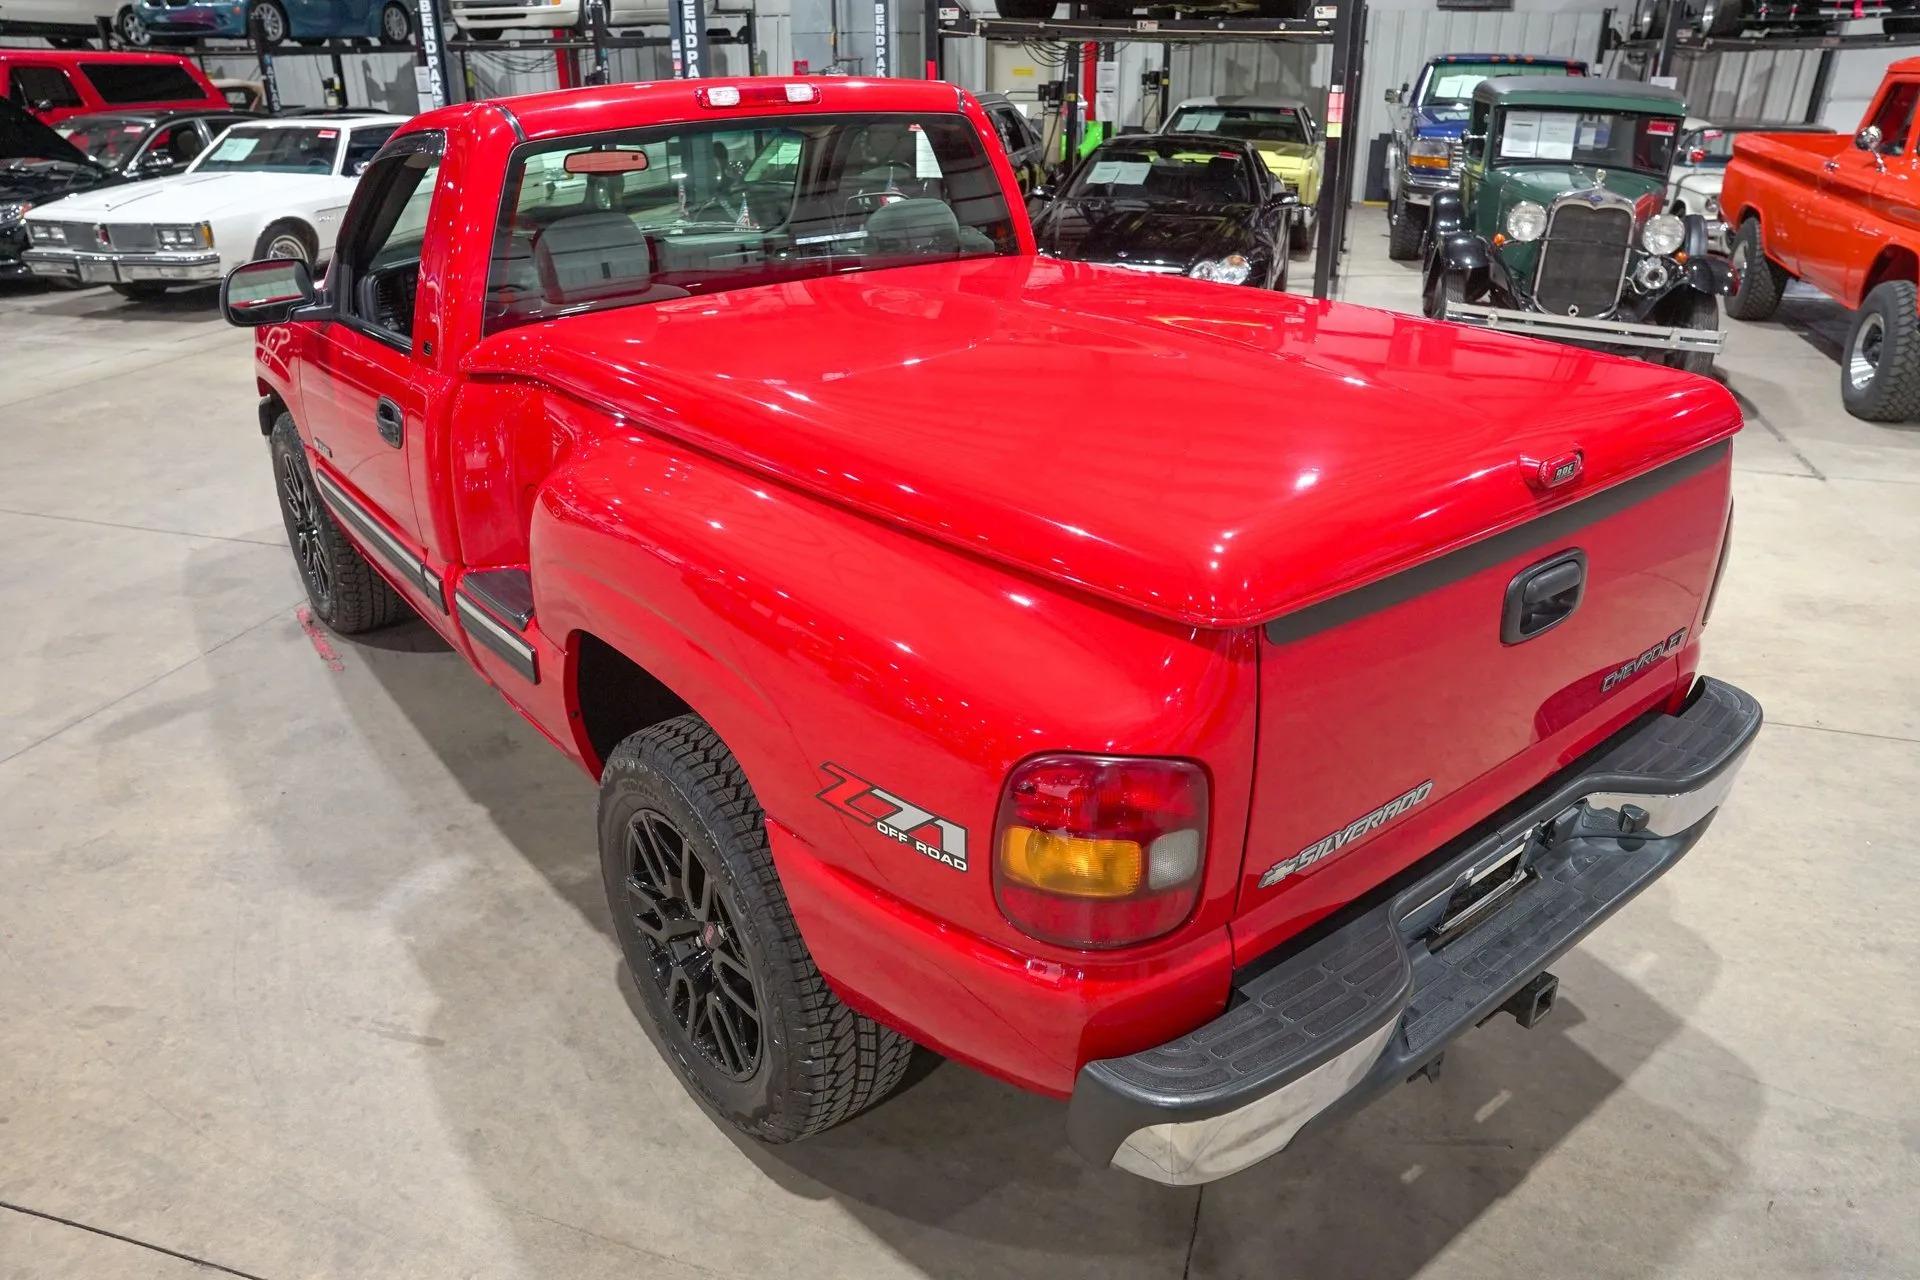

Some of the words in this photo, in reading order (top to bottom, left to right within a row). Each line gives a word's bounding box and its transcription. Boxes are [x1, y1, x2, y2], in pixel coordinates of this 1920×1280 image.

[419, 0, 442, 95] BENDPAK
[875, 3, 886, 78] BENDPAK
[816, 761, 968, 861] Z71
[876, 821, 908, 843] OFF
[915, 840, 967, 872] ROAD
[1294, 781, 1434, 872] SILVERADO
